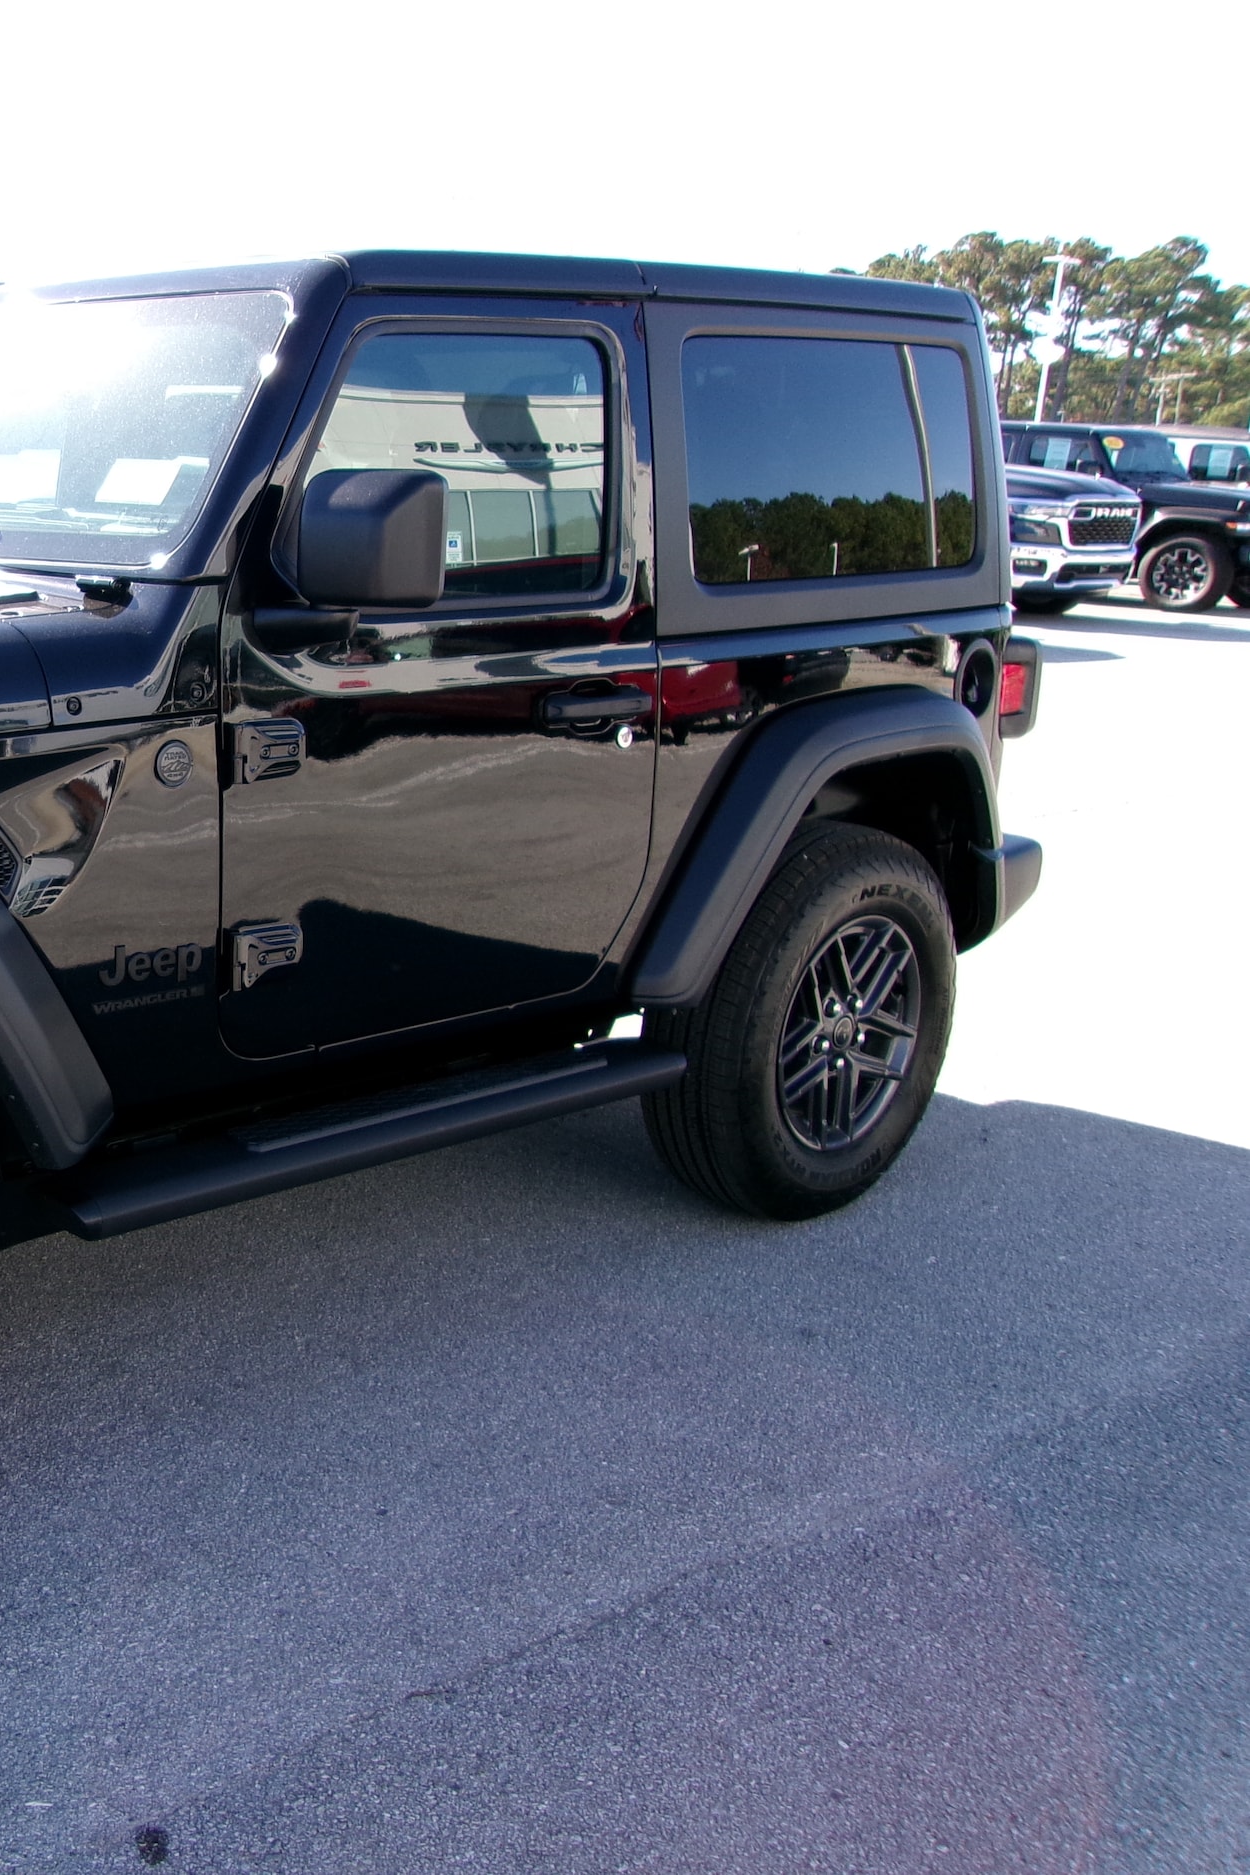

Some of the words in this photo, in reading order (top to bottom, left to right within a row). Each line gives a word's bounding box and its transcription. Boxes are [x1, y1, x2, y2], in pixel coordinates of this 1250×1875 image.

[1096, 507, 1133, 518] RAM
[98, 942, 203, 987] Jeep
[91, 988, 189, 1016] WRANGLER
